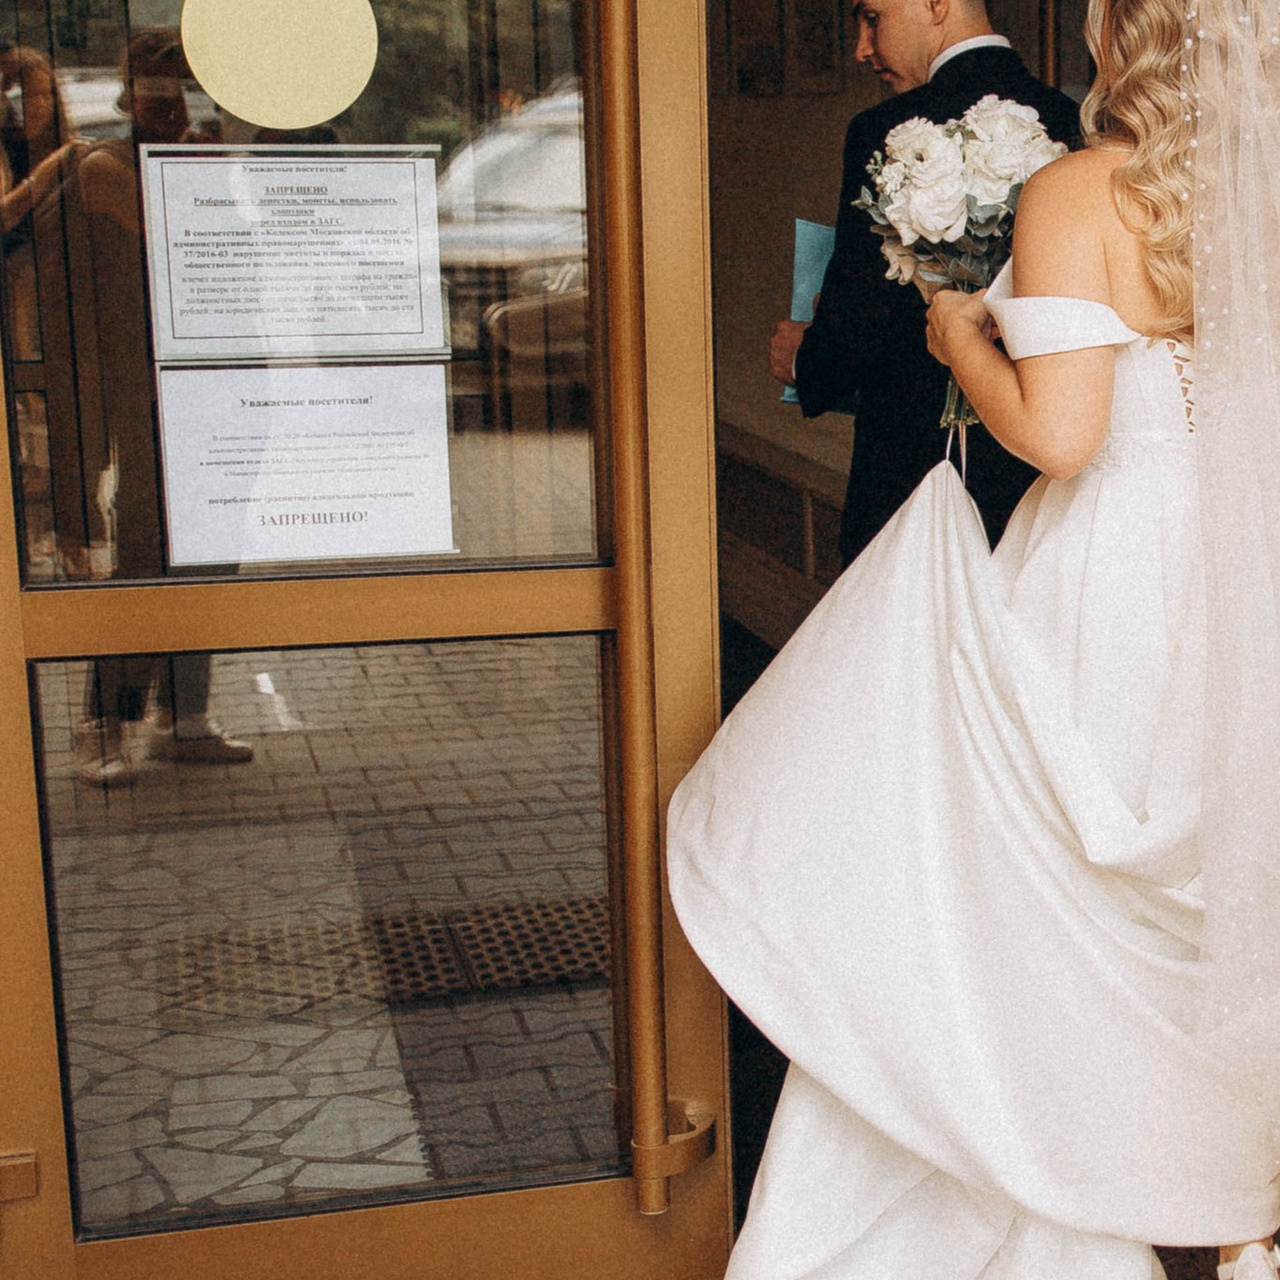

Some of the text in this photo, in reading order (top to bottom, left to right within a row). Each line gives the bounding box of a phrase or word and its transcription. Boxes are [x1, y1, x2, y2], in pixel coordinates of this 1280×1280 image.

[264, 185, 329, 195] ЗАПРЕЩЕНО
[240, 395, 373, 408] Уважаемые посетители!
[257, 511, 369, 527] ЗАПРЕЩЕНО!
